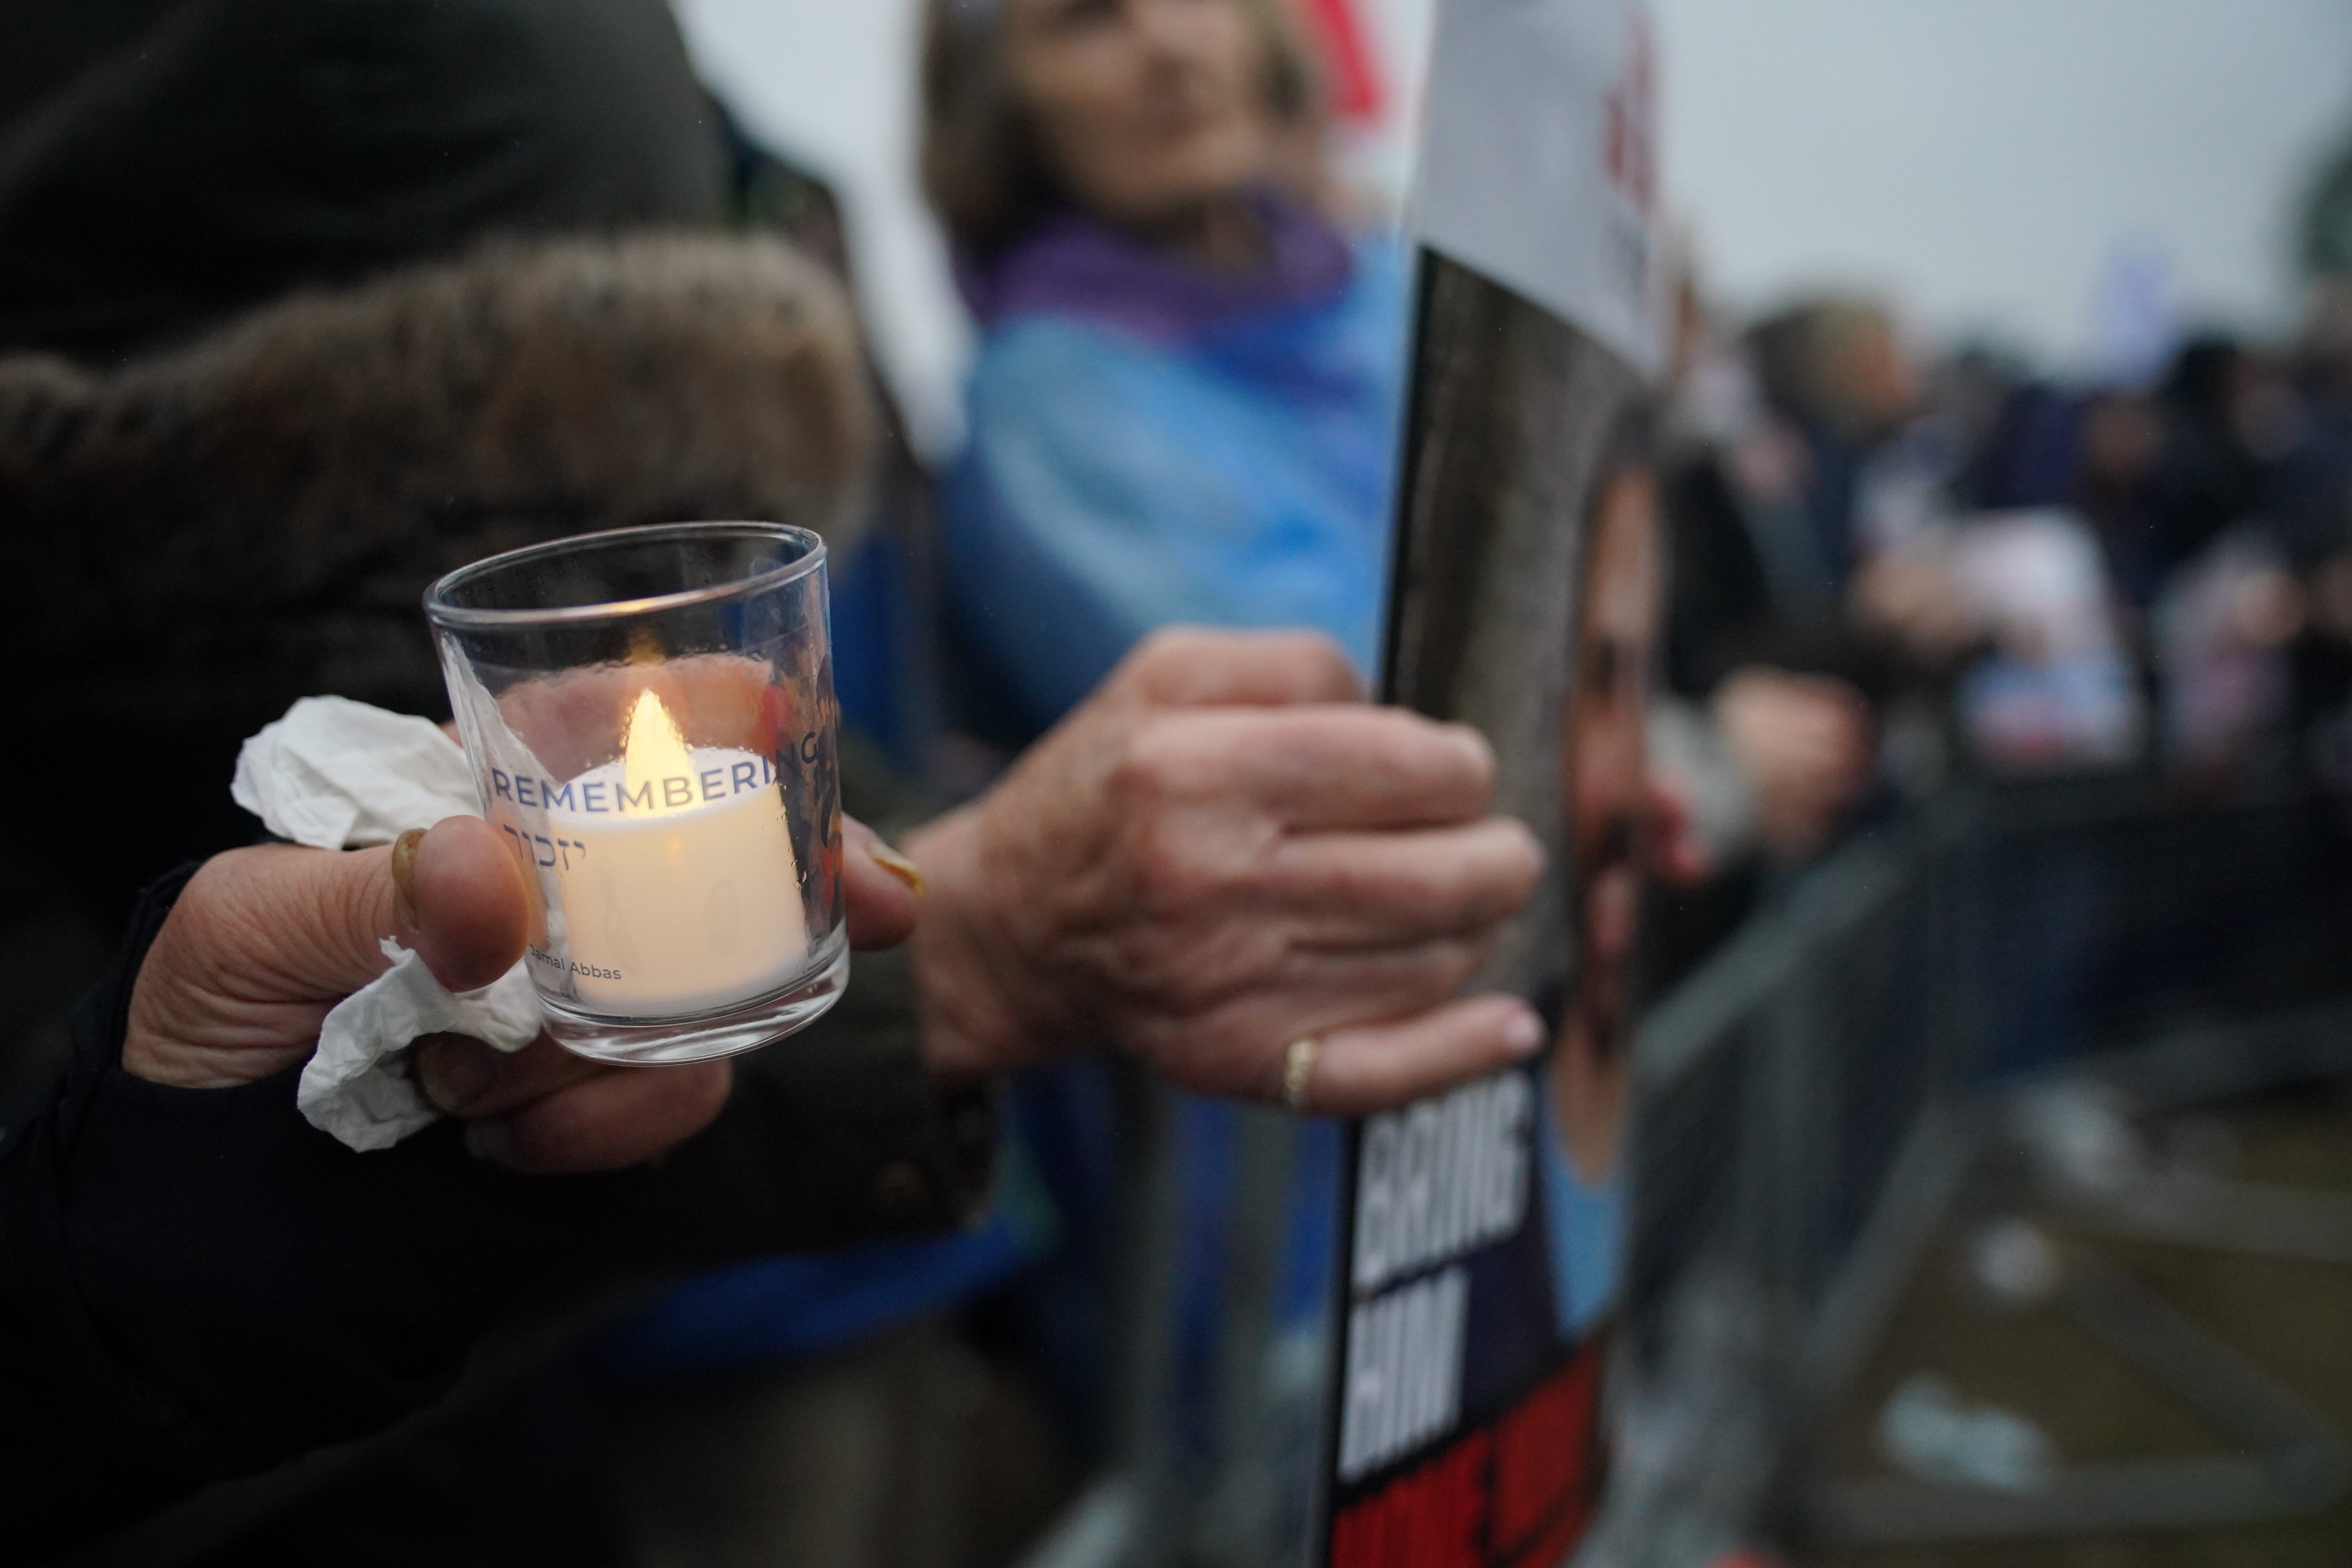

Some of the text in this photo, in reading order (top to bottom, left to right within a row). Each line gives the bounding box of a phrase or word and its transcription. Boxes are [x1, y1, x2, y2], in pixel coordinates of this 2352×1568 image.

[492, 731, 818, 812] REMEMBERING
[503, 824, 586, 871] יזכור
[529, 944, 622, 979] Jamal Abbas
[1354, 1069, 1532, 1290] BRING
[1337, 1263, 1470, 1483] HIM
